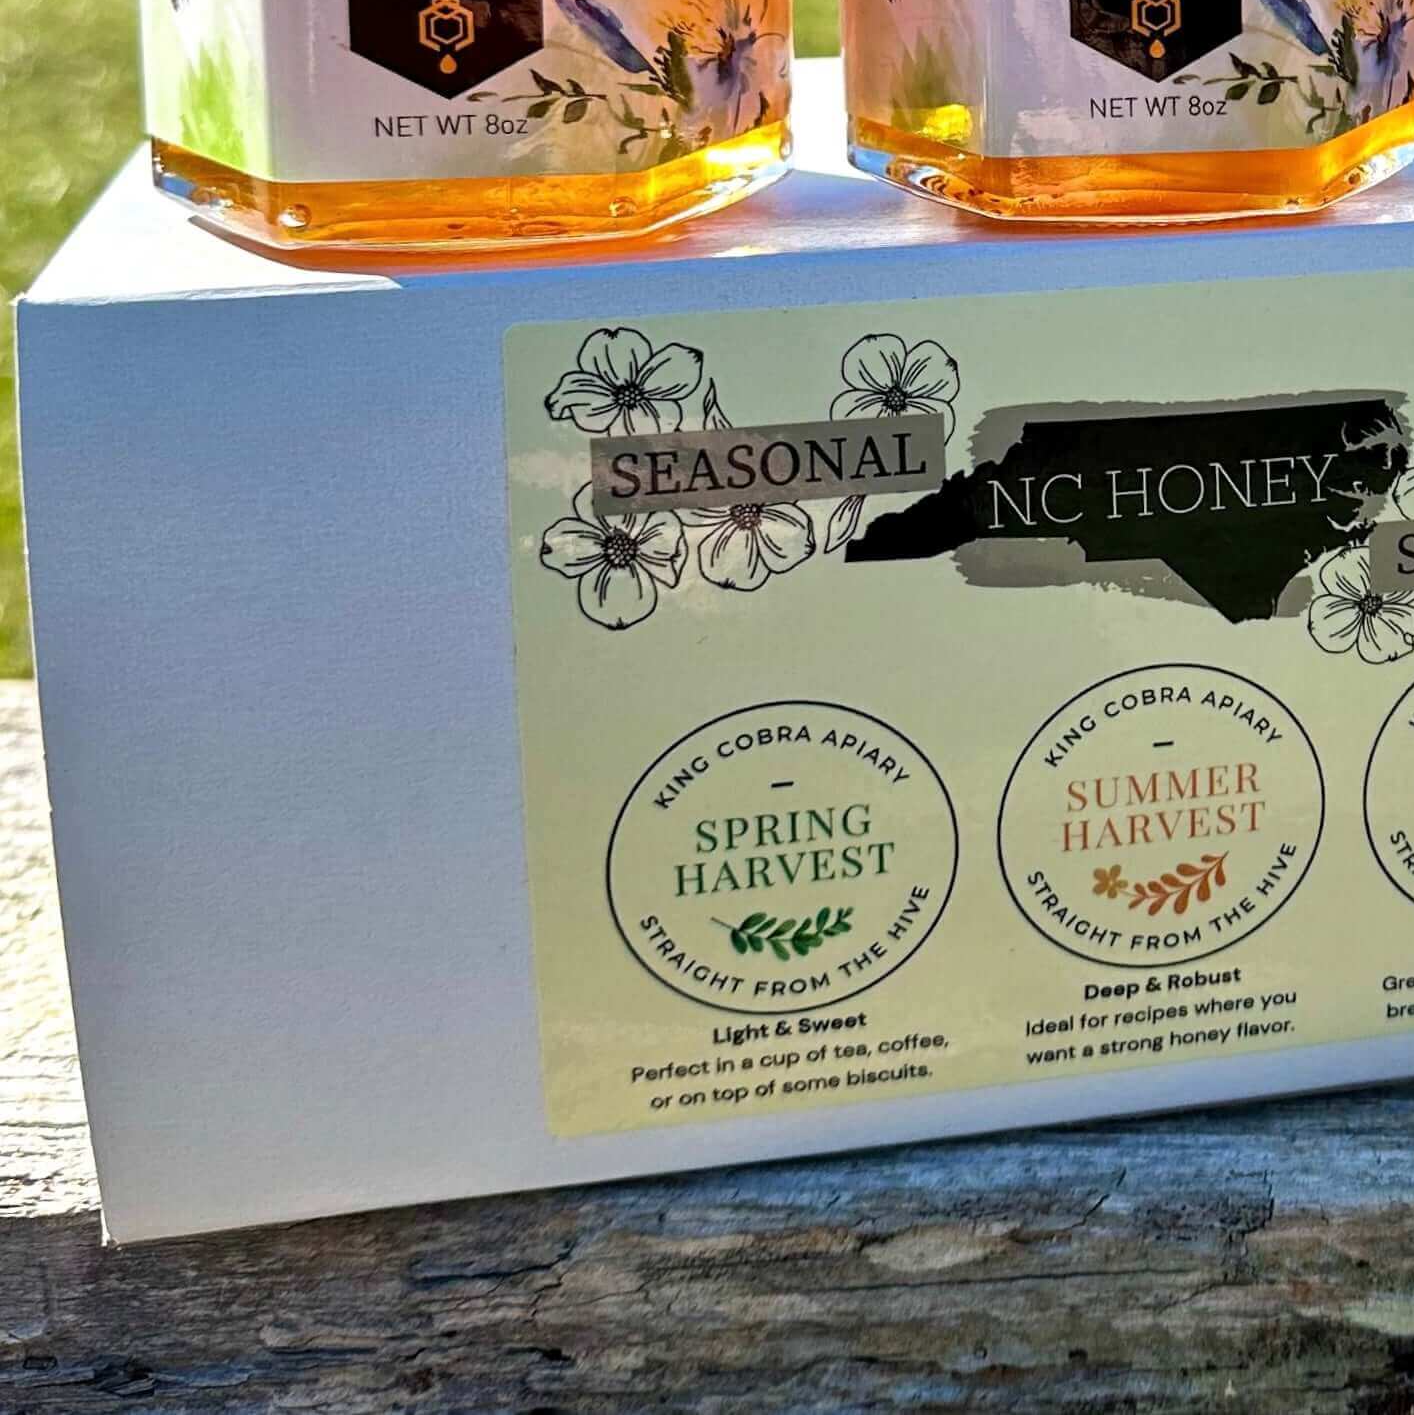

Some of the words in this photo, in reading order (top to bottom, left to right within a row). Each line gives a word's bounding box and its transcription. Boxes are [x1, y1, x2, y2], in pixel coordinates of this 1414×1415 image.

[374, 116, 428, 137] NET
[436, 115, 477, 135] WT
[486, 114, 529, 134] 8oz
[1090, 98, 1138, 118] NET
[1145, 96, 1180, 116] WT
[1188, 96, 1228, 115] 8oz
[610, 433, 927, 499] SEASONAL
[988, 473, 1083, 529] NC
[1105, 453, 1339, 521] HONEY
[1044, 715, 1098, 768] KING
[1103, 686, 1191, 718] COBRA
[1200, 690, 1283, 745] APIARY
[653, 755, 711, 810] KING
[717, 725, 812, 758] COBRA
[821, 729, 911, 784] APIARY
[1066, 762, 1262, 813] SUMMER
[695, 803, 873, 854] SPRING
[1060, 801, 1267, 853] HARVEST
[674, 842, 895, 898] HARVEST
[1026, 871, 1122, 949] STRAIGHT
[1130, 927, 1201, 950] FROM
[1208, 898, 1256, 933] THE
[1258, 843, 1297, 898] HIVE
[639, 915, 745, 995] STRAIGHT
[753, 972, 831, 997] FROM
[838, 941, 888, 979] THE
[892, 885, 930, 941] HIVE
[1084, 982, 1140, 1001] Deep
[1145, 977, 1161, 992] &
[1167, 968, 1242, 989] Robust
[712, 1024, 769, 1045] Light
[775, 1020, 793, 1036] &
[798, 1012, 868, 1034] Sweet
[1025, 1016, 1074, 1036] Ideal
[1080, 1013, 1108, 1030] for
[1114, 1005, 1188, 1024] recipes
[1194, 996, 1254, 1015] where
[1261, 991, 1297, 1010] you
[631, 1061, 709, 1083] Perfect
[716, 1057, 735, 1072] in
[741, 1058, 753, 1070] a
[760, 1051, 801, 1069] cup
[806, 1045, 827, 1062] of
[834, 1043, 872, 1059] tea,
[878, 1033, 950, 1053] coffee,
[1026, 1046, 1076, 1065] want
[1082, 1044, 1094, 1058] a
[1100, 1035, 1163, 1055] strong
[1170, 1026, 1231, 1046] honey
[1236, 1018, 1295, 1038] flavor.
[651, 1096, 672, 1109] or
[678, 1092, 706, 1105] on
[712, 1084, 749, 1103] top
[755, 1082, 775, 1098] of
[783, 1076, 841, 1093] some
[846, 1063, 933, 1086] biscuits.
